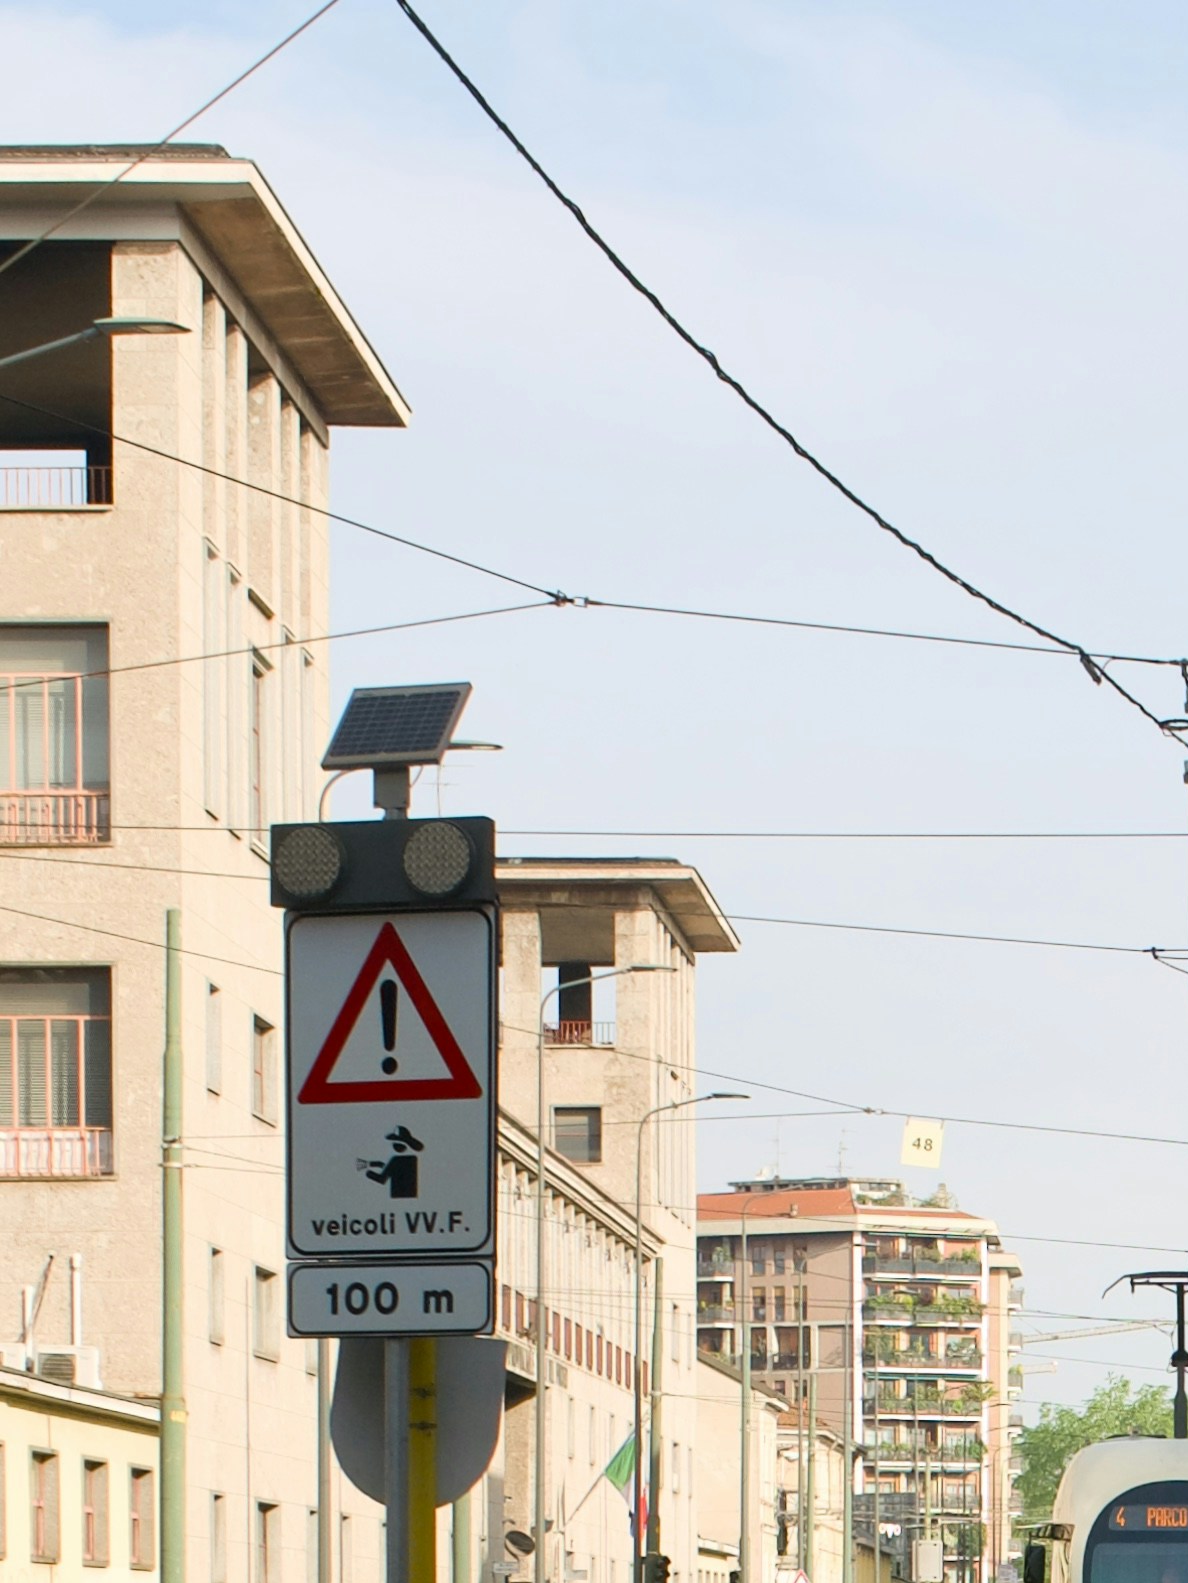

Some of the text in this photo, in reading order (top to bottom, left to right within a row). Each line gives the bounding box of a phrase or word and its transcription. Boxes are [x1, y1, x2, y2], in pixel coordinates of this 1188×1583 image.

[912, 1137, 933, 1152] 48
[311, 1211, 470, 1236] veicoli VV.F.
[326, 1281, 454, 1316] 100 m
[1116, 1506, 1126, 1527] 4
[1146, 1506, 1188, 1528] PARCO
